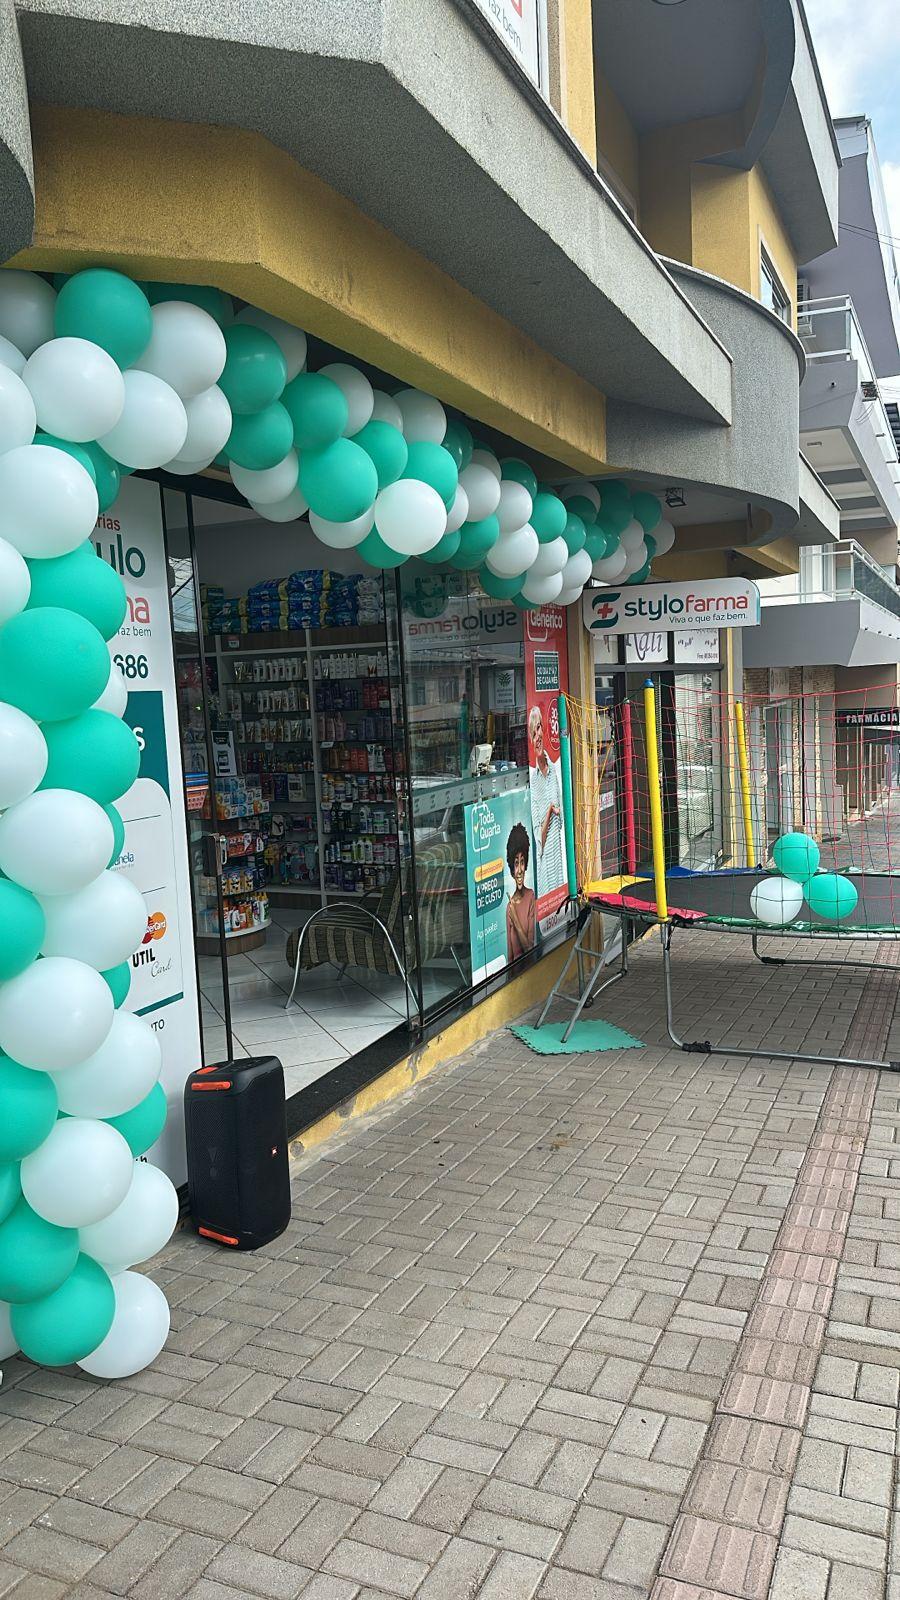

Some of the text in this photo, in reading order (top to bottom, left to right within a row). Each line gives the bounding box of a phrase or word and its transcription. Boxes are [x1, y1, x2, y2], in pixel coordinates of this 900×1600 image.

[95, 514, 121, 531] rias
[624, 594, 748, 621] stylofarma
[669, 615, 687, 624] Viva
[695, 615, 710, 624] que
[712, 613, 725, 621] faz
[479, 812, 495, 825] Toda
[480, 823, 501, 839] Quarta
[477, 889, 502, 908] DE CUSTO
[132, 948, 156, 968] UTIL
[151, 957, 172, 978] Card
